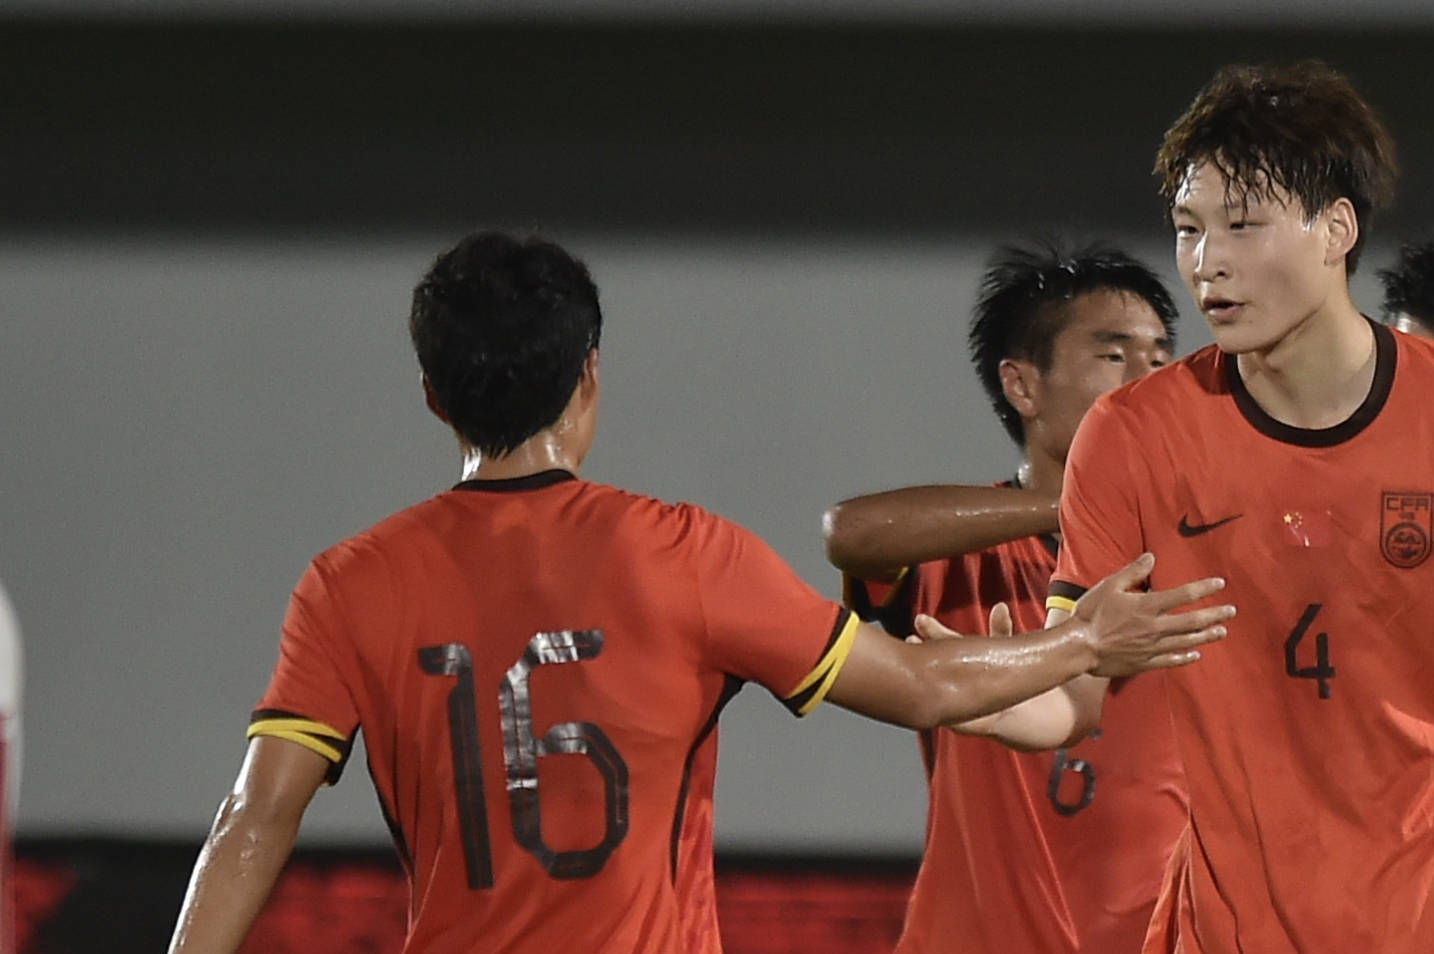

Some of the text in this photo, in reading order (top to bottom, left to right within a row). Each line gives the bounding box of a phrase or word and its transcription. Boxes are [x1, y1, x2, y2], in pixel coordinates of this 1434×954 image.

[1285, 603, 1336, 699] 4
[418, 630, 629, 890] 16
[1047, 728, 1103, 817] 6
